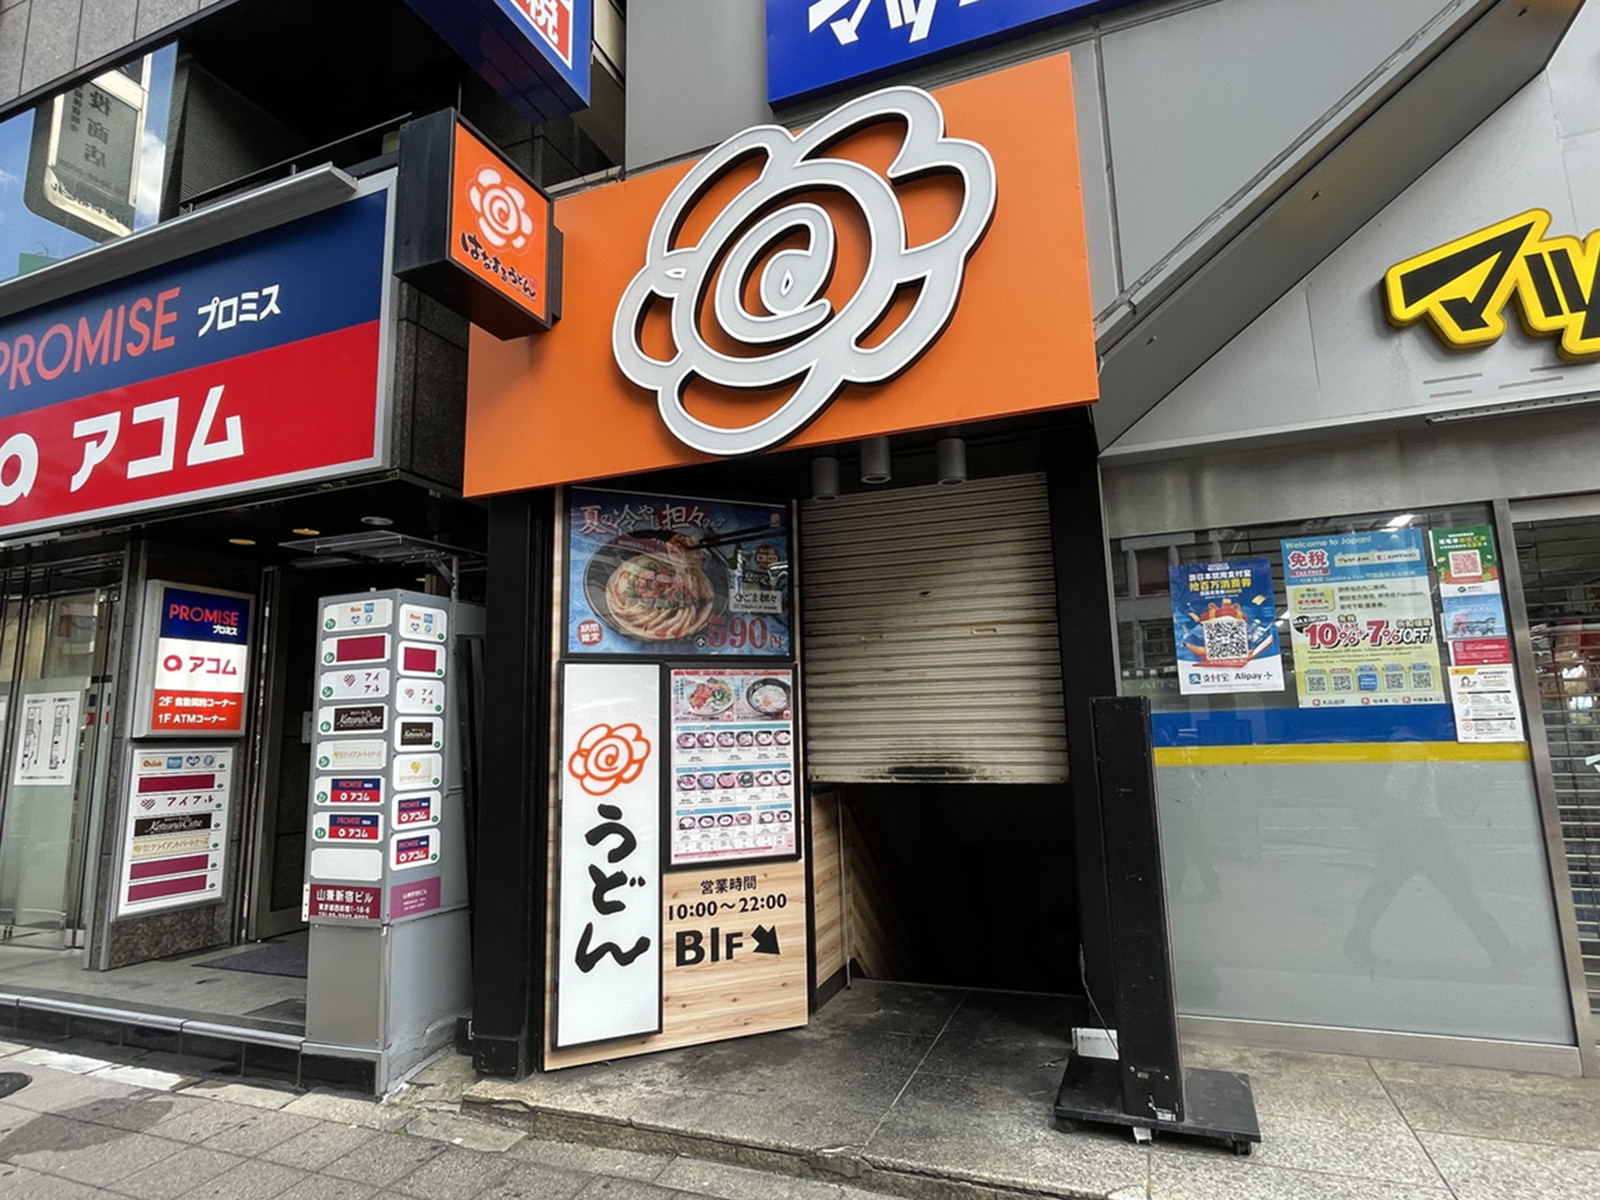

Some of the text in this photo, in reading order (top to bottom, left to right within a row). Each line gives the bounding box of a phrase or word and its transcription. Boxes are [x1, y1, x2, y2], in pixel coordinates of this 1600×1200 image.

[198, 284, 282, 337] プロミス
[70, 384, 244, 493] アコム
[1286, 539, 1327, 549] Welcome
[1341, 535, 1372, 546] Japan!
[169, 604, 239, 625] PROMISE
[188, 656, 238, 676] アコム
[158, 696, 173, 707] 2F
[158, 713, 227, 724] 1F ATMコーナー
[575, 803, 652, 973] うどん
[700, 875, 757, 896] 営業時間
